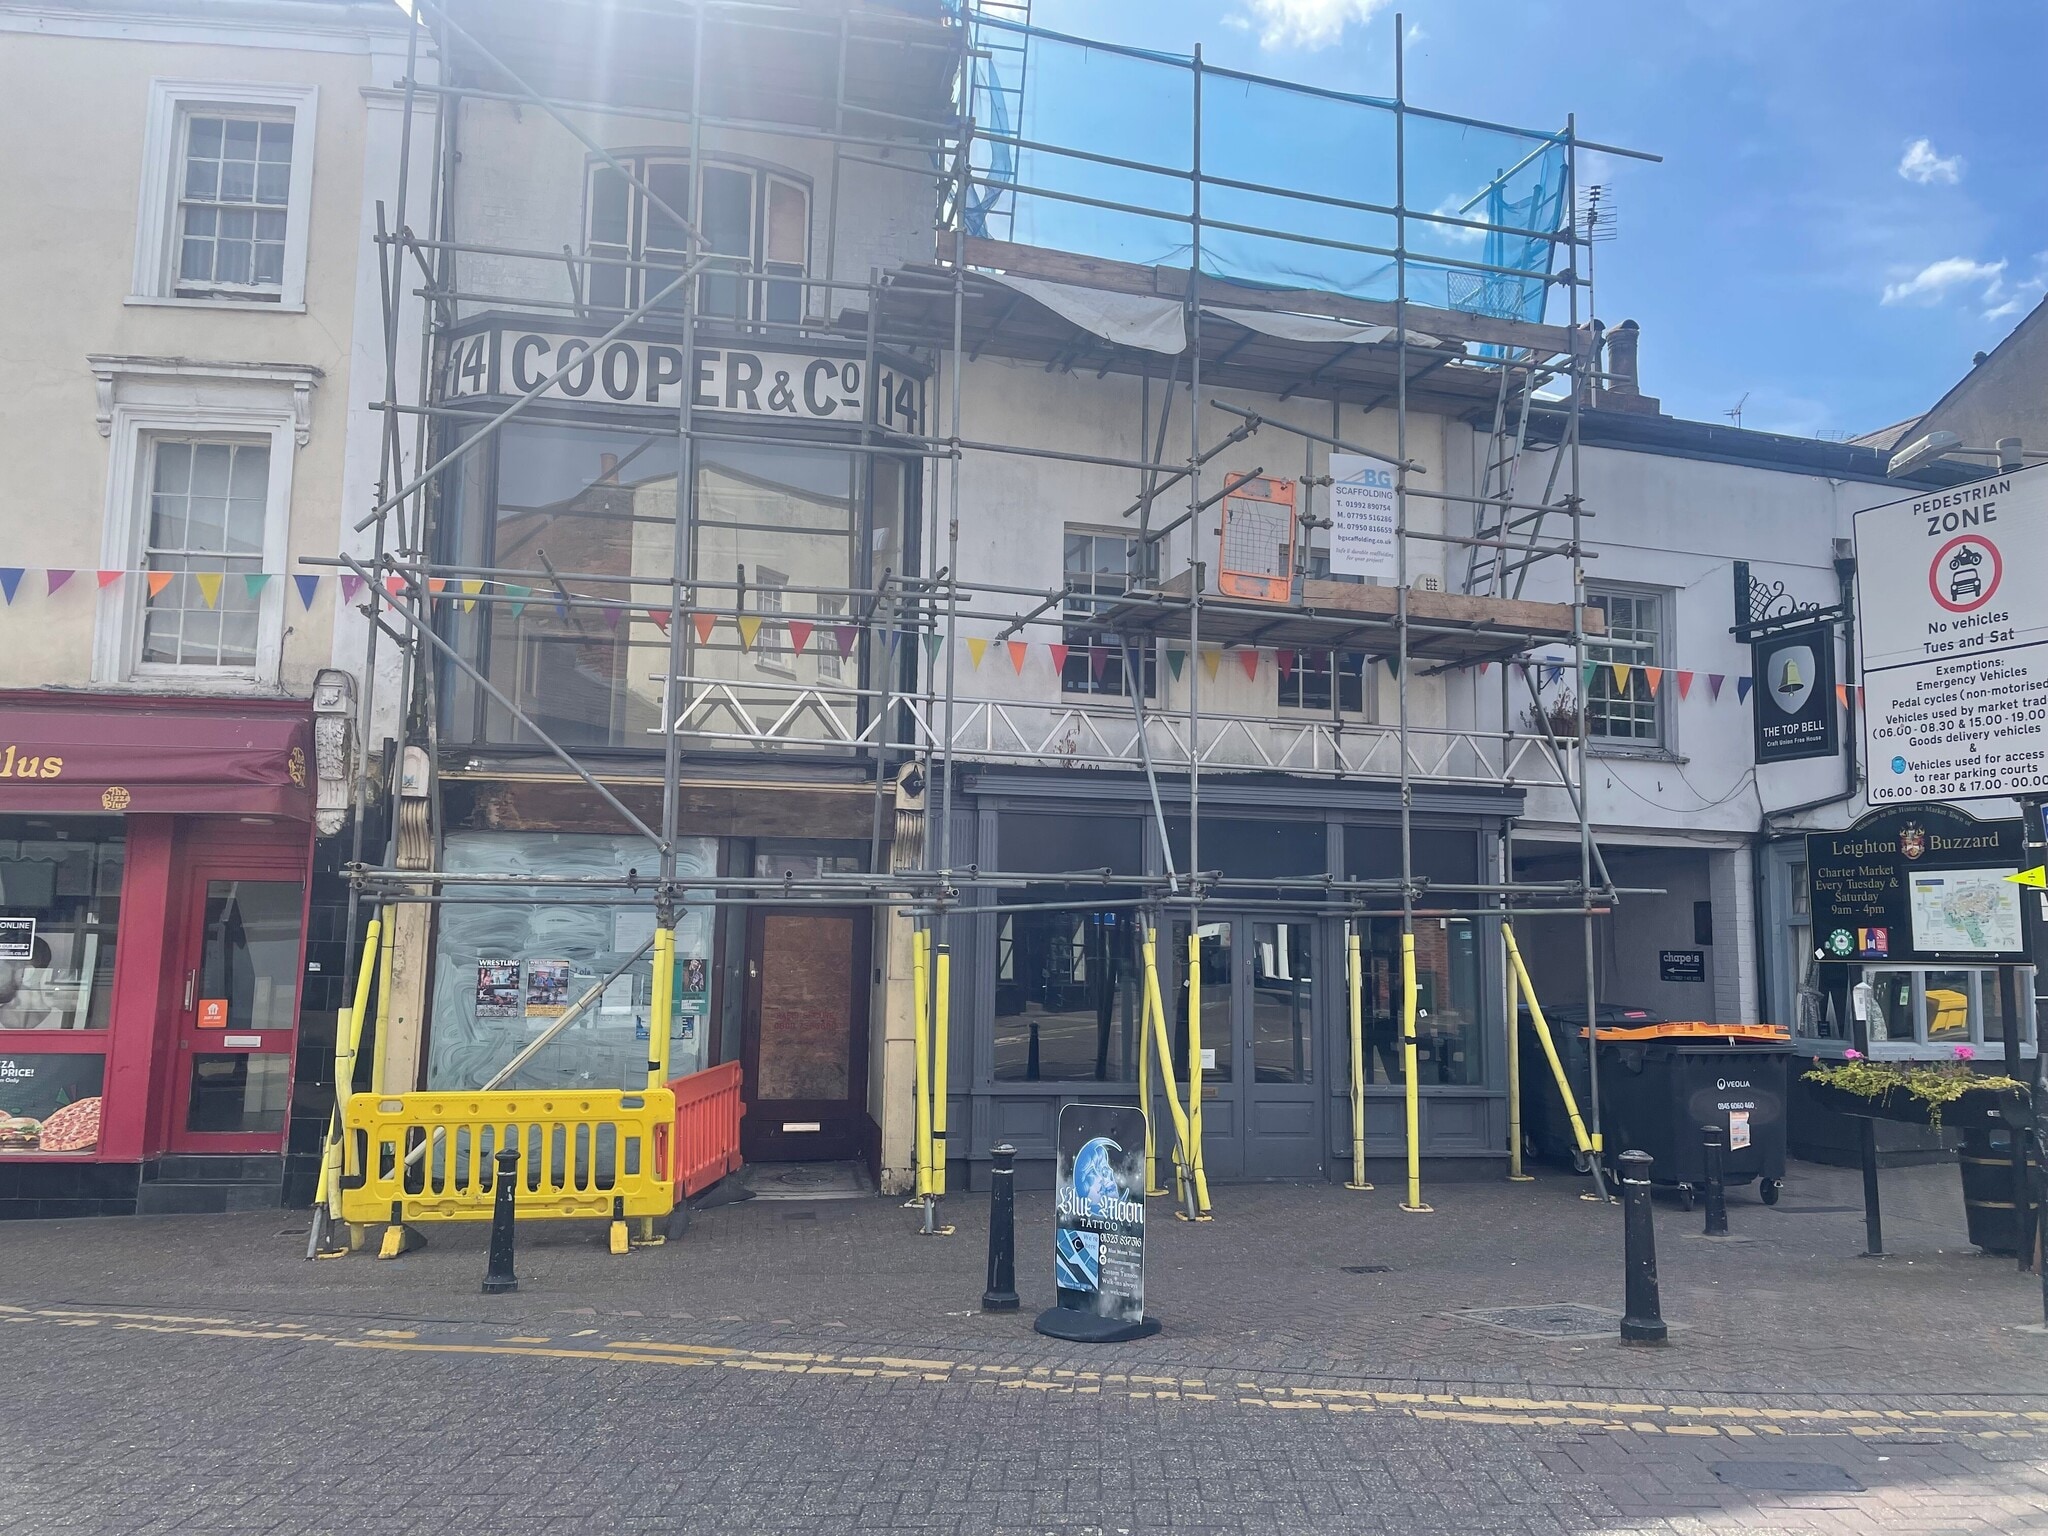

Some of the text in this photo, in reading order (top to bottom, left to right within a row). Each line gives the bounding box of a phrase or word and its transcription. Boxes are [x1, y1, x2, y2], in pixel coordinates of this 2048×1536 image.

[452, 334, 487, 397] 14
[512, 334, 763, 411] COOPER
[881, 370, 919, 434] 14
[1364, 469, 1391, 487] BG
[1335, 487, 1393, 500] SCAFFOLDING
[1913, 480, 2011, 516] PEDESTRIAN
[1345, 500, 1366, 509] 01992
[1367, 502, 1391, 511] 890754
[1346, 512, 1368, 520] 07795
[1927, 502, 1998, 536] ZONE
[1337, 522, 1346, 530] M.
[1346, 523, 1368, 531] 07950
[1338, 535, 1392, 545] bgscaffolding.co.uk
[1928, 610, 2009, 635] No vehicles
[1924, 628, 2015, 654] Tues and Sat
[1936, 659, 2004, 677] Exemptions:
[1916, 666, 2028, 691] Emergency Vehicles
[1892, 696, 1921, 709] Pedal
[1924, 692, 1958, 705] cycles
[1886, 712, 1929, 725] Vehicles
[1932, 707, 1957, 719] used
[1961, 705, 1974, 717] by
[1978, 698, 2019, 713] market
[1763, 720, 1824, 738] THE TOP BELL
[1872, 725, 1912, 740] (06.00
[1920, 720, 1954, 734] 08.30
[1958, 719, 1966, 729] &
[1970, 714, 2002, 728] 15.00
[2012, 708, 2046, 722] 19.00
[1766, 739, 1779, 747] Craft
[1780, 738, 1793, 746] Union
[1806, 735, 1821, 743] House
[1909, 723, 2041, 747] Goods delivery vehicles
[1969, 743, 1977, 752] &
[0, 745, 64, 778] lus
[1908, 750, 2045, 771] Vehicles used for access
[1914, 763, 2039, 783] to rear parking courts
[103, 793, 130, 802] Pizza
[110, 787, 126, 796] The
[1873, 785, 1912, 800] (06.00
[1920, 783, 1955, 795] 08.30
[1959, 782, 1967, 792] &
[1970, 779, 2002, 791] 17.00
[104, 801, 127, 810] Plus
[1855, 816, 1879, 831] Welcome
[1925, 805, 1947, 816] Market
[1948, 811, 1964, 822] Town
[1832, 831, 2000, 858] Leighton Buzzard
[1818, 865, 1894, 878] Charter Market
[1815, 877, 1899, 891] Every Tuesday &
[1835, 891, 1879, 903] Saturday
[1831, 904, 1852, 915] 9am
[1863, 904, 1885, 917] 4pm
[0, 921, 30, 929] ONLINE
[1830, 928, 1853, 939] STREET
[479, 959, 520, 967] WRESTLING
[1, 1068, 34, 1077] PRICE!
[1726, 1080, 1751, 1088] VEOLIA
[1057, 1187, 1144, 1224] Blue Moon
[1080, 1218, 1118, 1231] TATTOO
